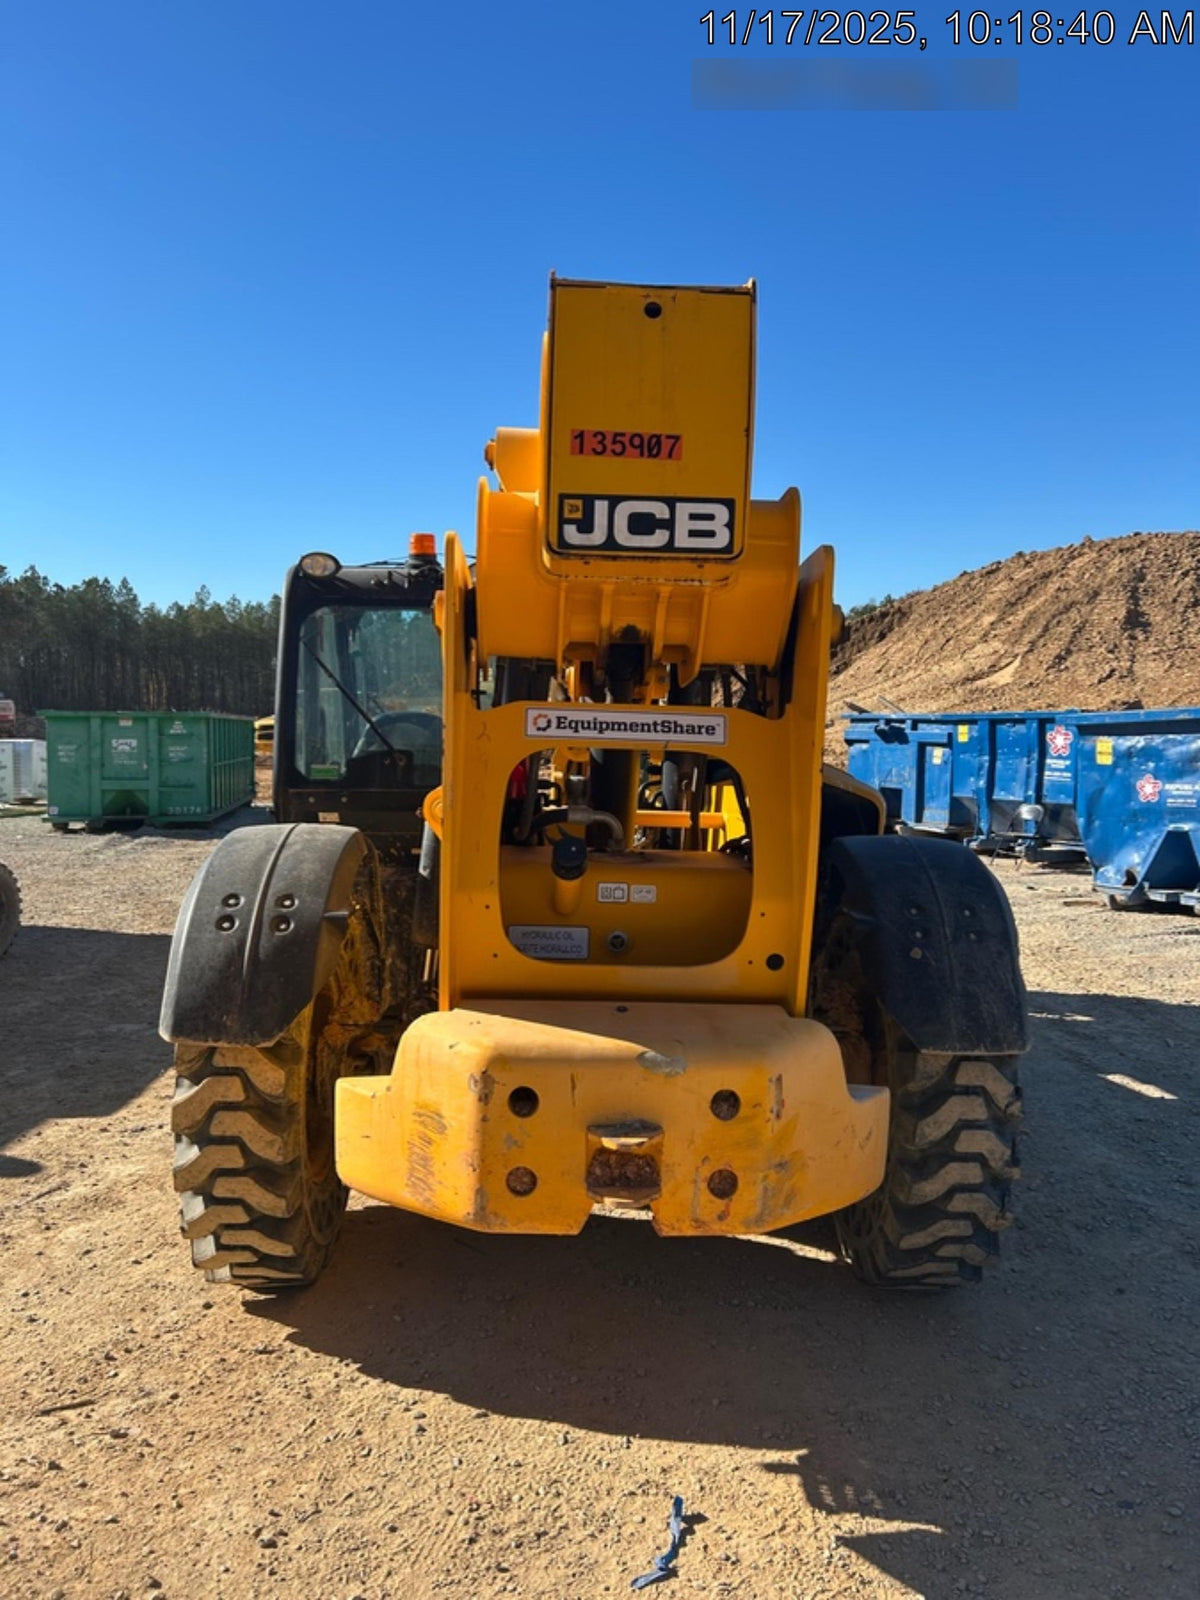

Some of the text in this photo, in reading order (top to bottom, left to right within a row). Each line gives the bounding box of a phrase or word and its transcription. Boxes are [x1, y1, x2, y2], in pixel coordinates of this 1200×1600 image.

[573, 429, 681, 459] 135907
[563, 499, 731, 549] JCB
[555, 715, 716, 736] EquipmentShare
